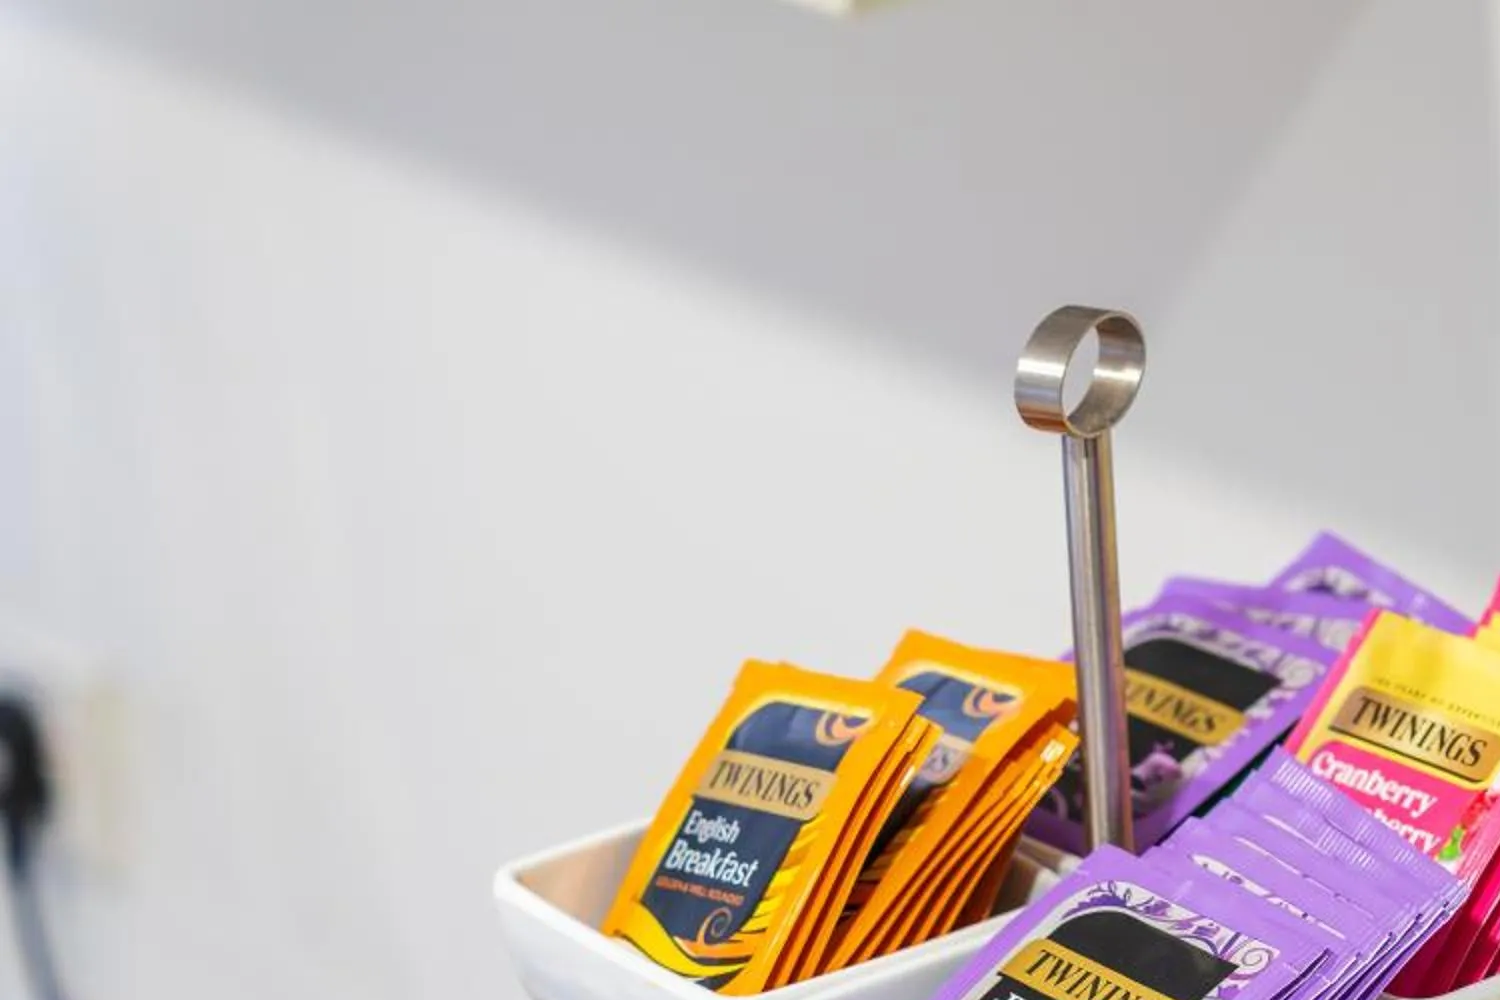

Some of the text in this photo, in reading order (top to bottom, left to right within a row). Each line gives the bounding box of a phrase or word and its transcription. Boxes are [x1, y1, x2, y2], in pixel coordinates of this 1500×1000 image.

[1353, 696, 1488, 767] TWININGS
[709, 760, 820, 808] TWININGS
[1311, 751, 1439, 819] Cranberry
[684, 809, 740, 844] English
[665, 837, 759, 887] Breakfast
